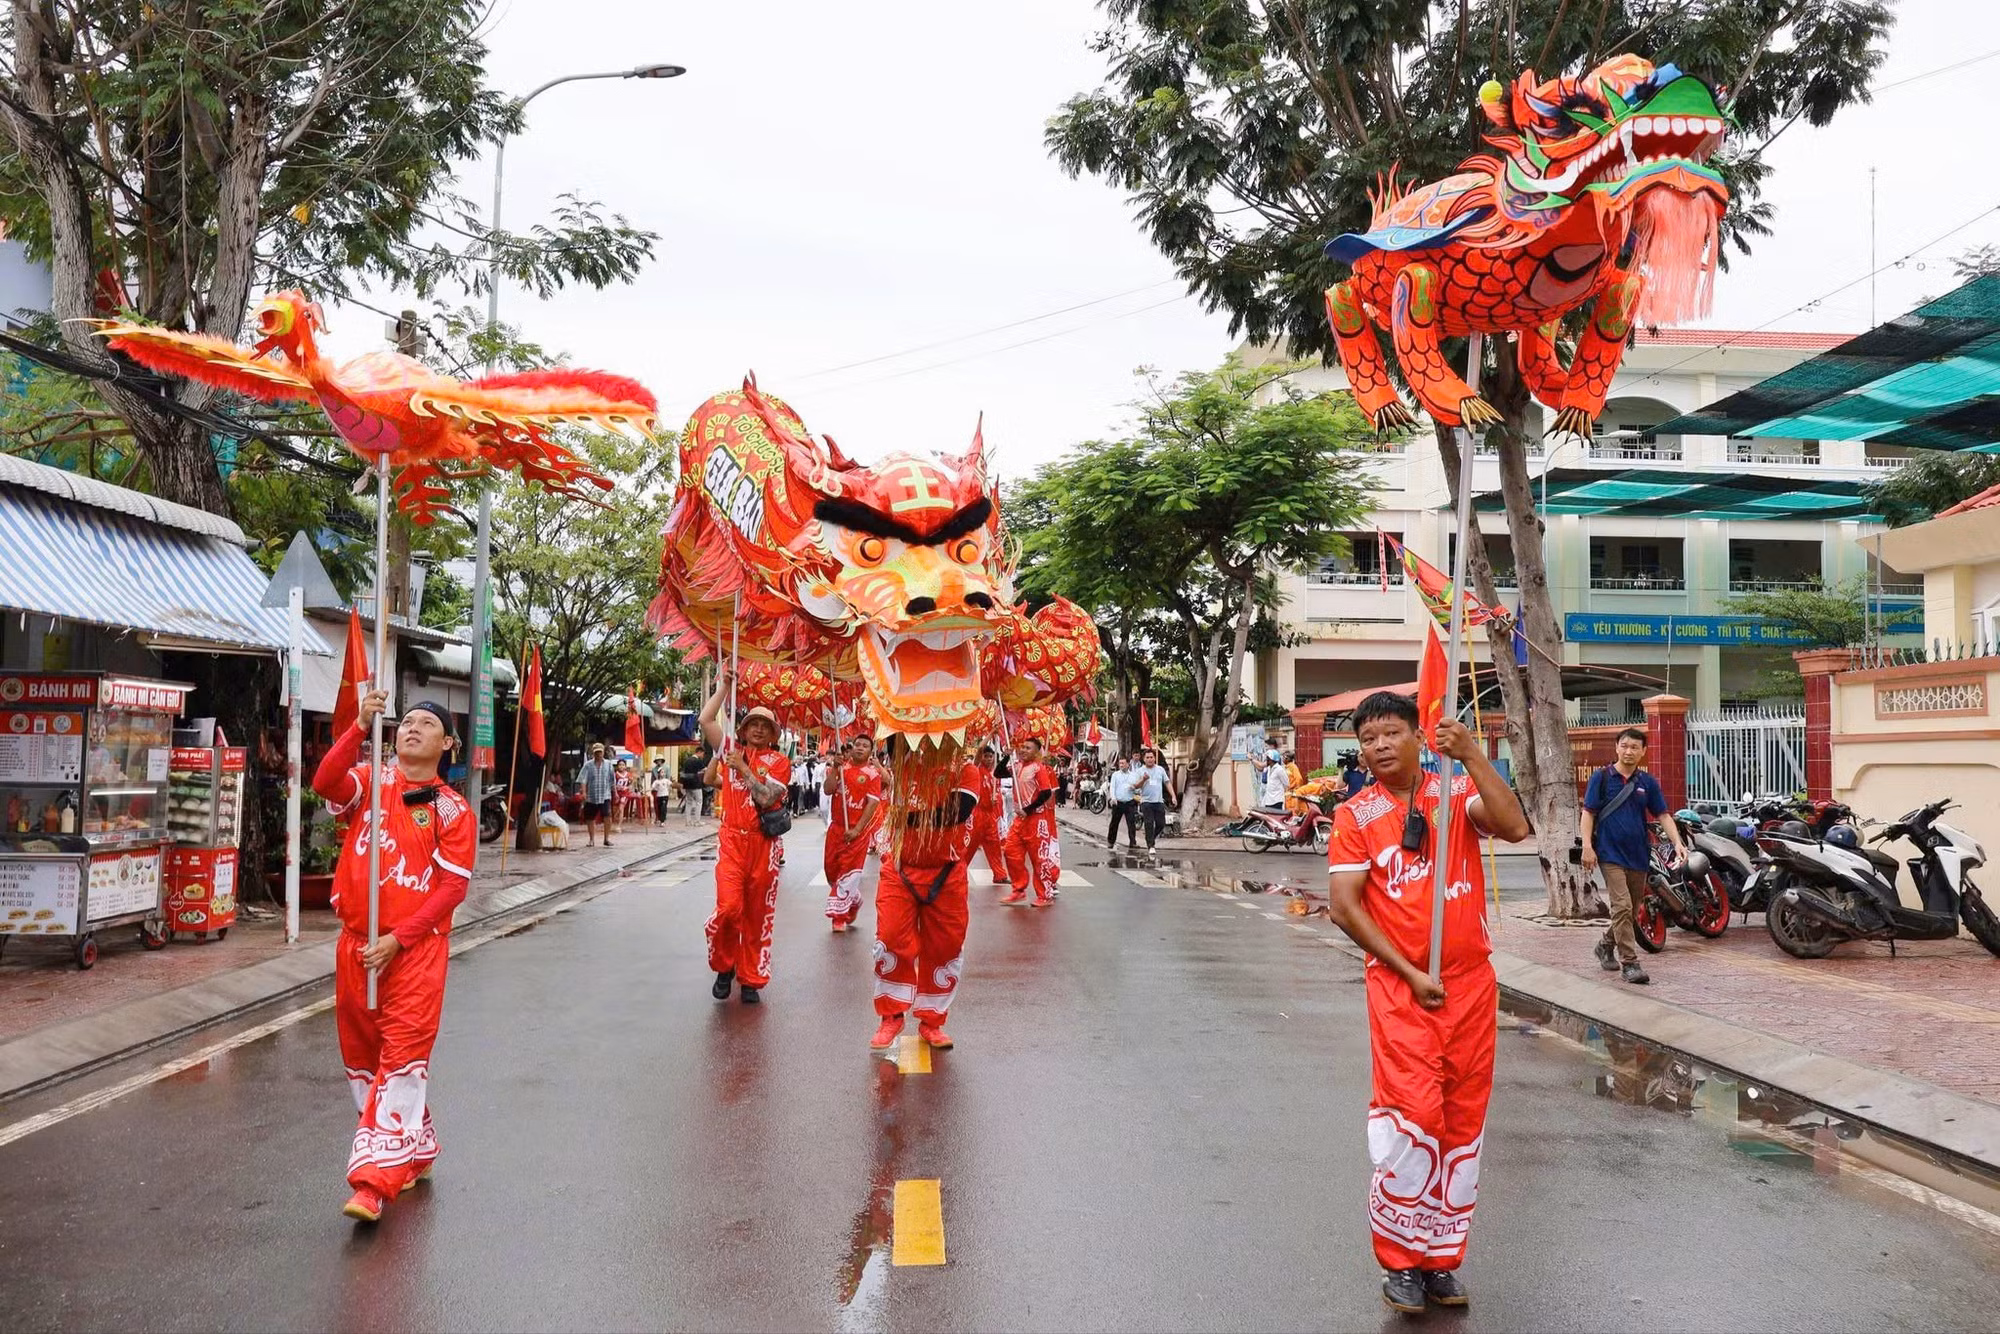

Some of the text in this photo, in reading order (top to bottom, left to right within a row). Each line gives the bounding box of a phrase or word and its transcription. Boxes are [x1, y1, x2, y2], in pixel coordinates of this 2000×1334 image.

[1593, 620, 1611, 635] YÊU
[1614, 622, 1651, 636] THƯƠNG
[1675, 624, 1708, 637] CƯƠNG
[29, 680, 91, 698] BÁNH MÌ
[113, 685, 137, 704] BÁNH
[138, 687, 149, 705] MÌ
[379, 854, 434, 894] Anh
